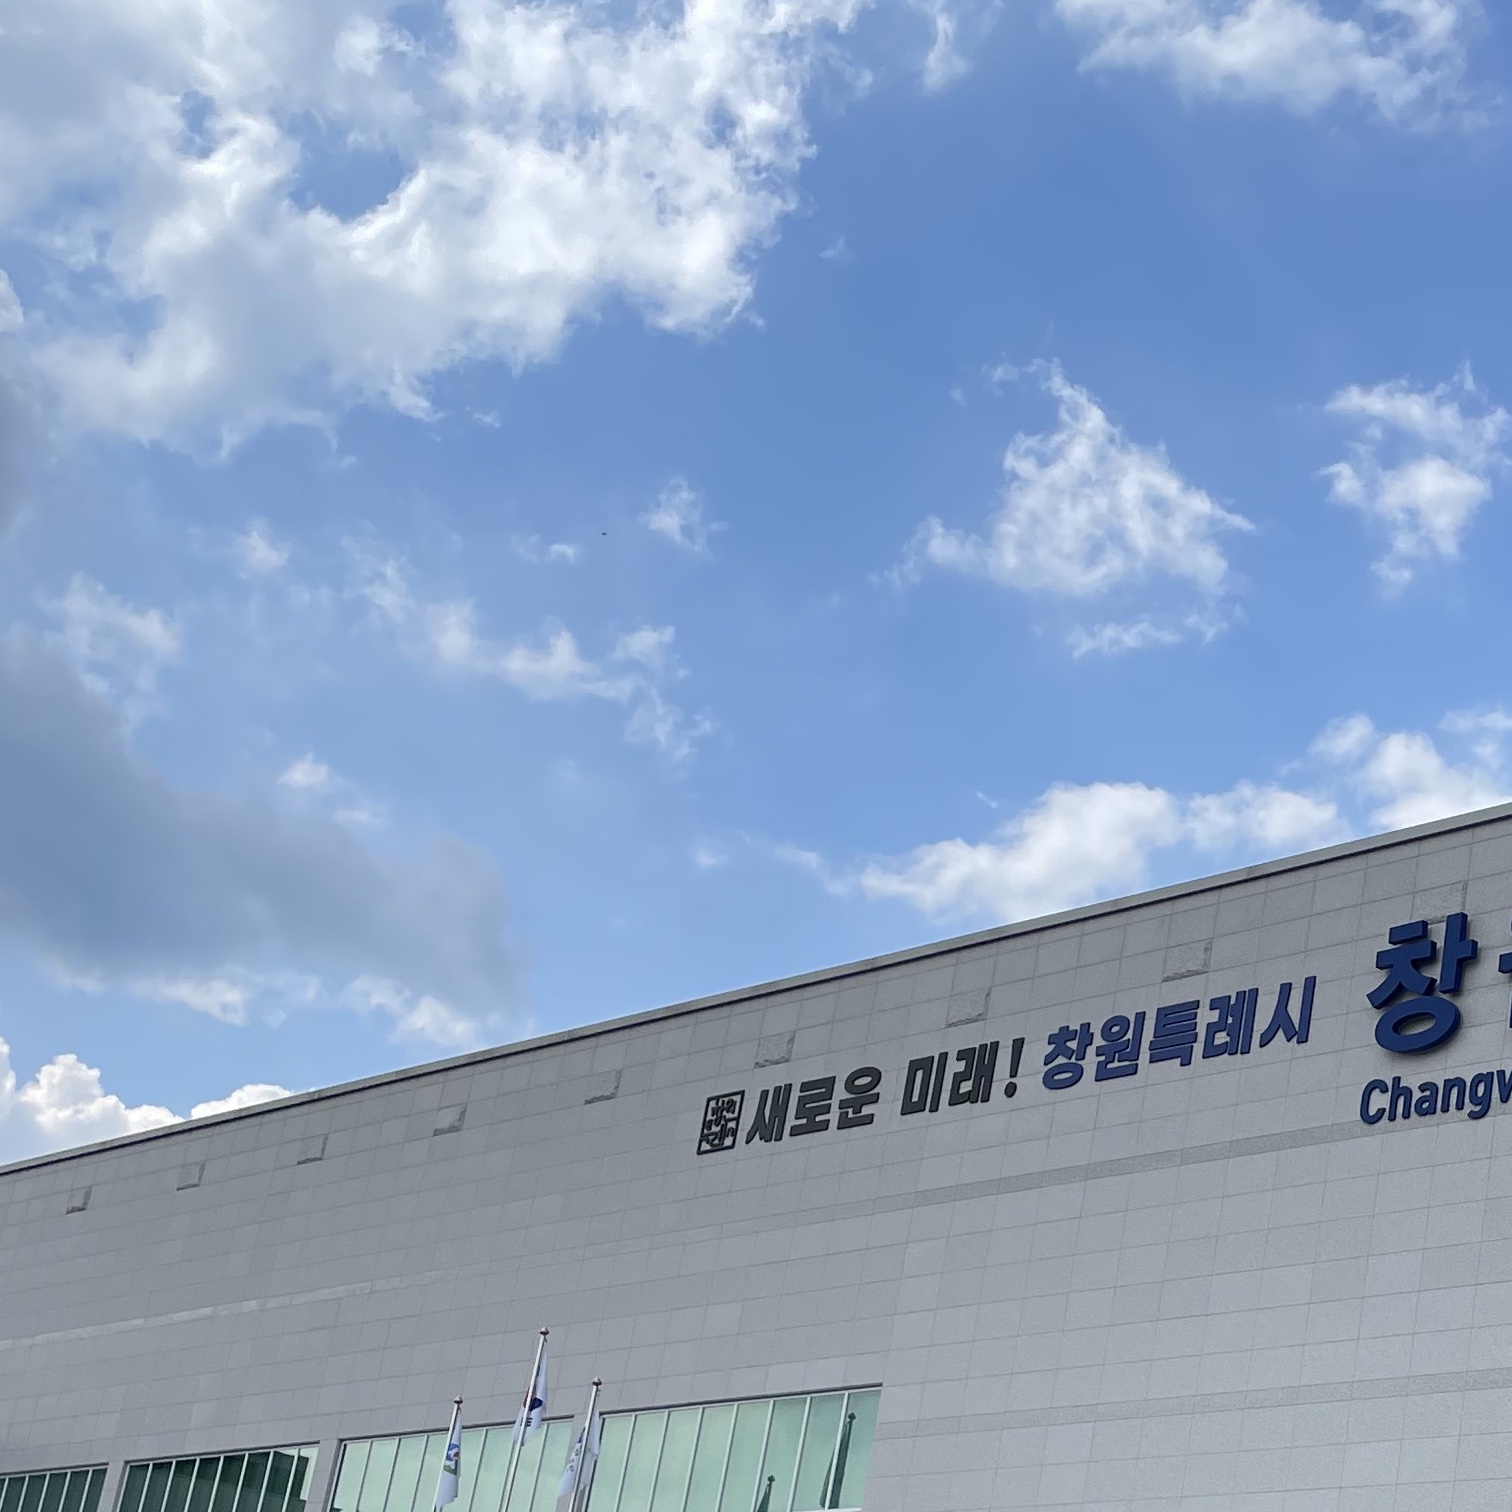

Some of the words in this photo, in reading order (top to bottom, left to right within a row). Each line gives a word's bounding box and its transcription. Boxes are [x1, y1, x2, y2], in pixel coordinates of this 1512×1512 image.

[745, 1066, 882, 1145] 새로운
[900, 1037, 1025, 1116] 미래!
[1041, 976, 1317, 1091] 창원특례시
